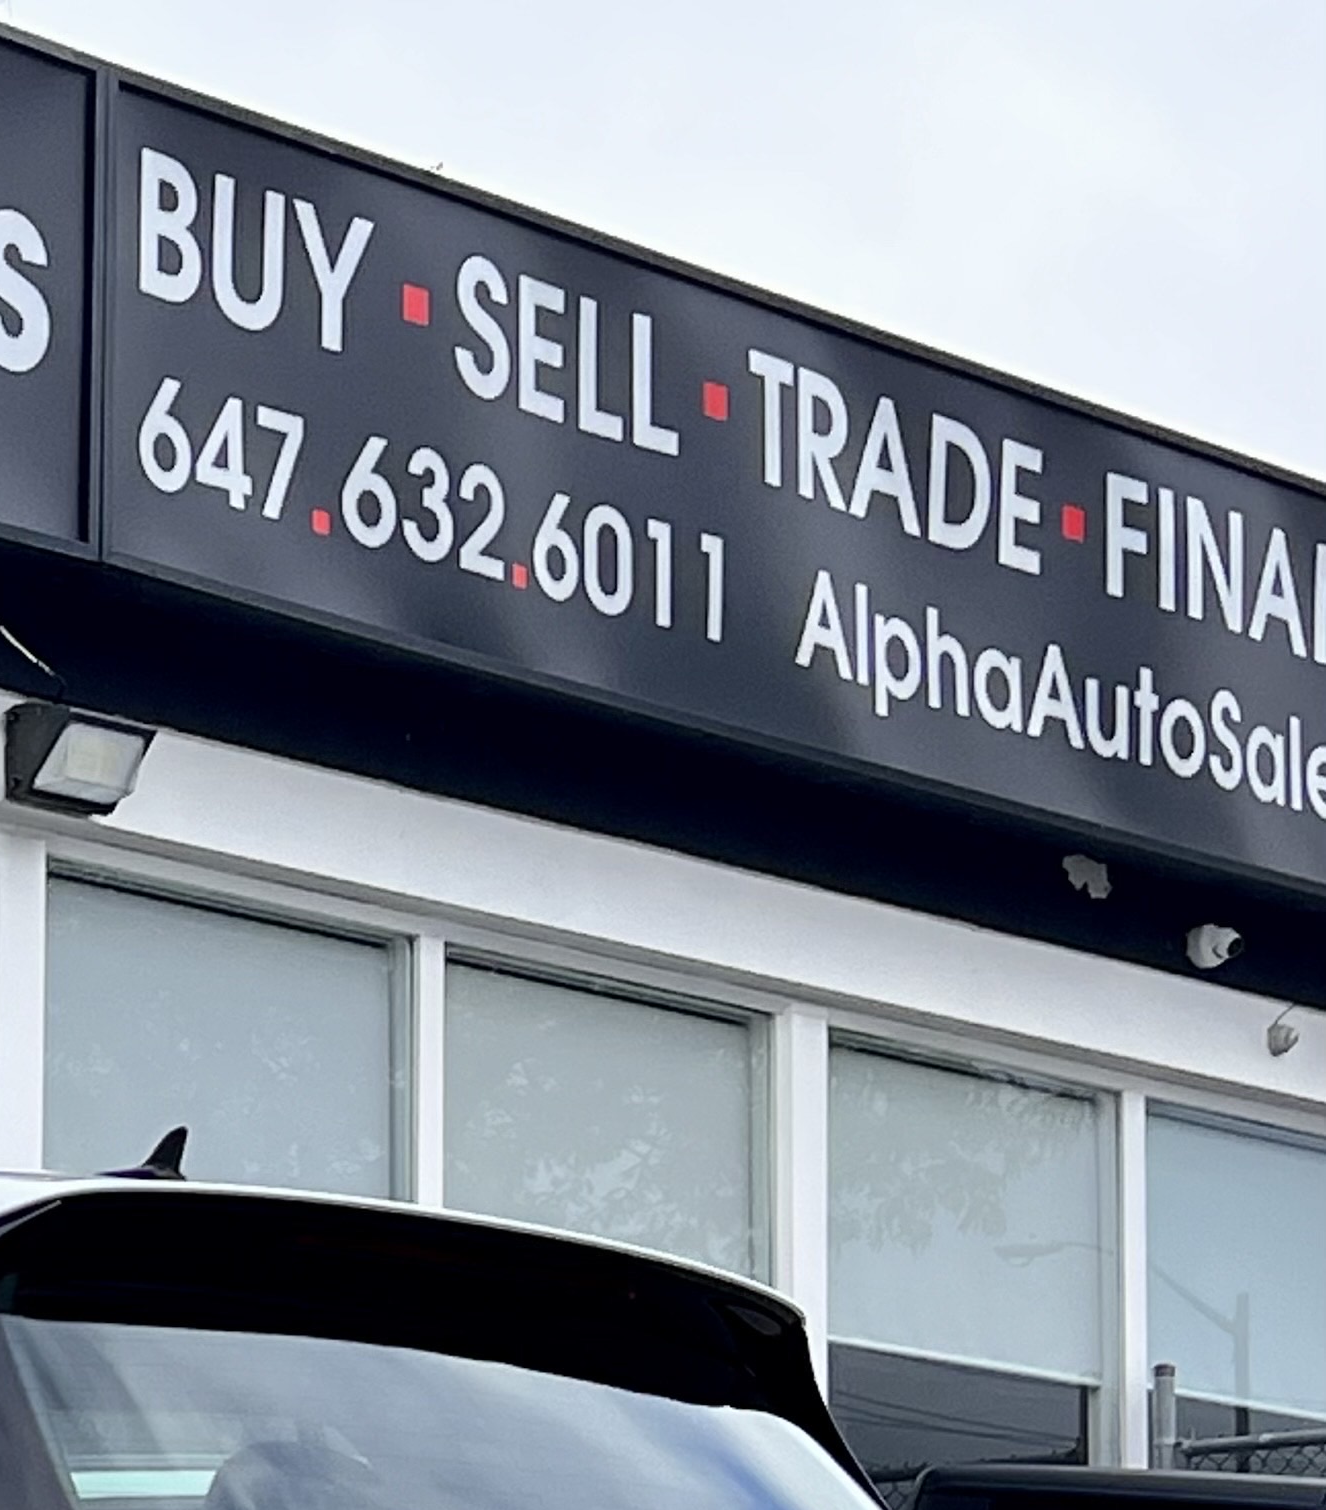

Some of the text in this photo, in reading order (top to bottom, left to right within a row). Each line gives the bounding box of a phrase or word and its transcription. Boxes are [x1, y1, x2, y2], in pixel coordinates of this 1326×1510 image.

[139, 147, 374, 352] BUY
[454, 256, 679, 456] SELL
[748, 349, 1042, 575] TRADE
[139, 377, 723, 642] 647.632.6011
